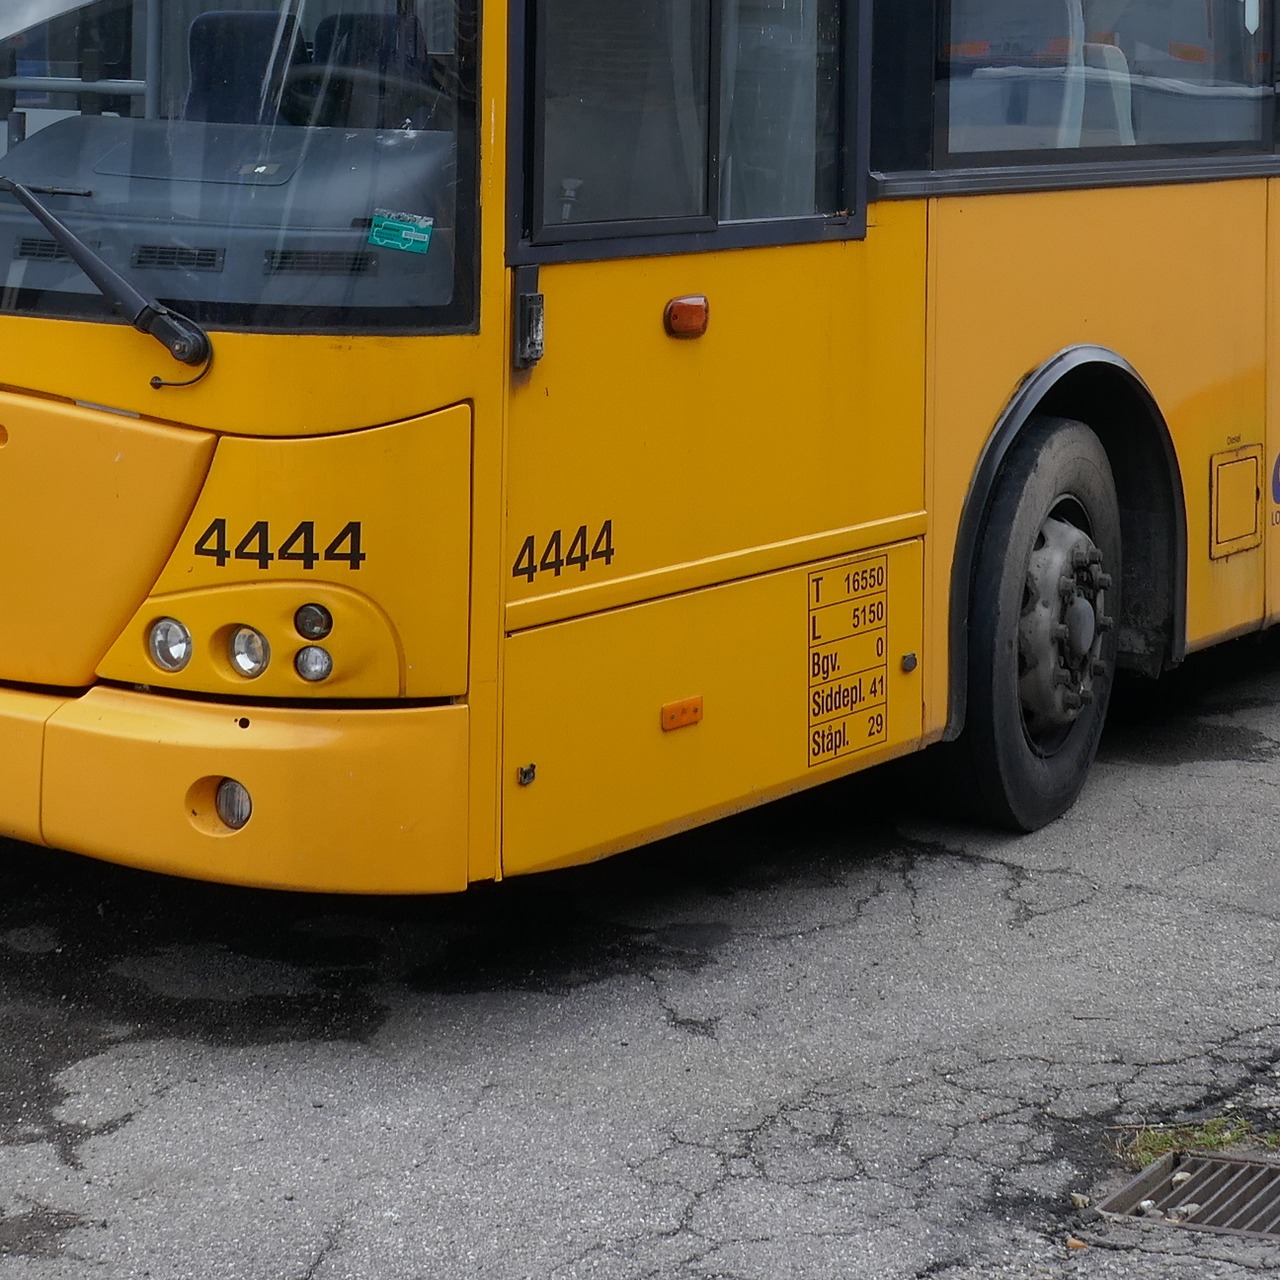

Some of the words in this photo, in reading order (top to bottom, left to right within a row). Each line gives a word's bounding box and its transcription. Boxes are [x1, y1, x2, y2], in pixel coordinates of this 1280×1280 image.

[194, 518, 367, 570] 4444
[512, 520, 615, 583] 4444
[812, 577, 823, 603] T
[844, 566, 884, 594] 16550
[812, 616, 821, 640] L
[852, 601, 884, 628] 5150
[812, 652, 840, 680] Bgv.
[876, 637, 883, 657] 0
[812, 678, 865, 717] Siddepl.
[869, 675, 884, 697] 41
[812, 722, 849, 756] Ståpl.
[867, 713, 883, 737] 29
